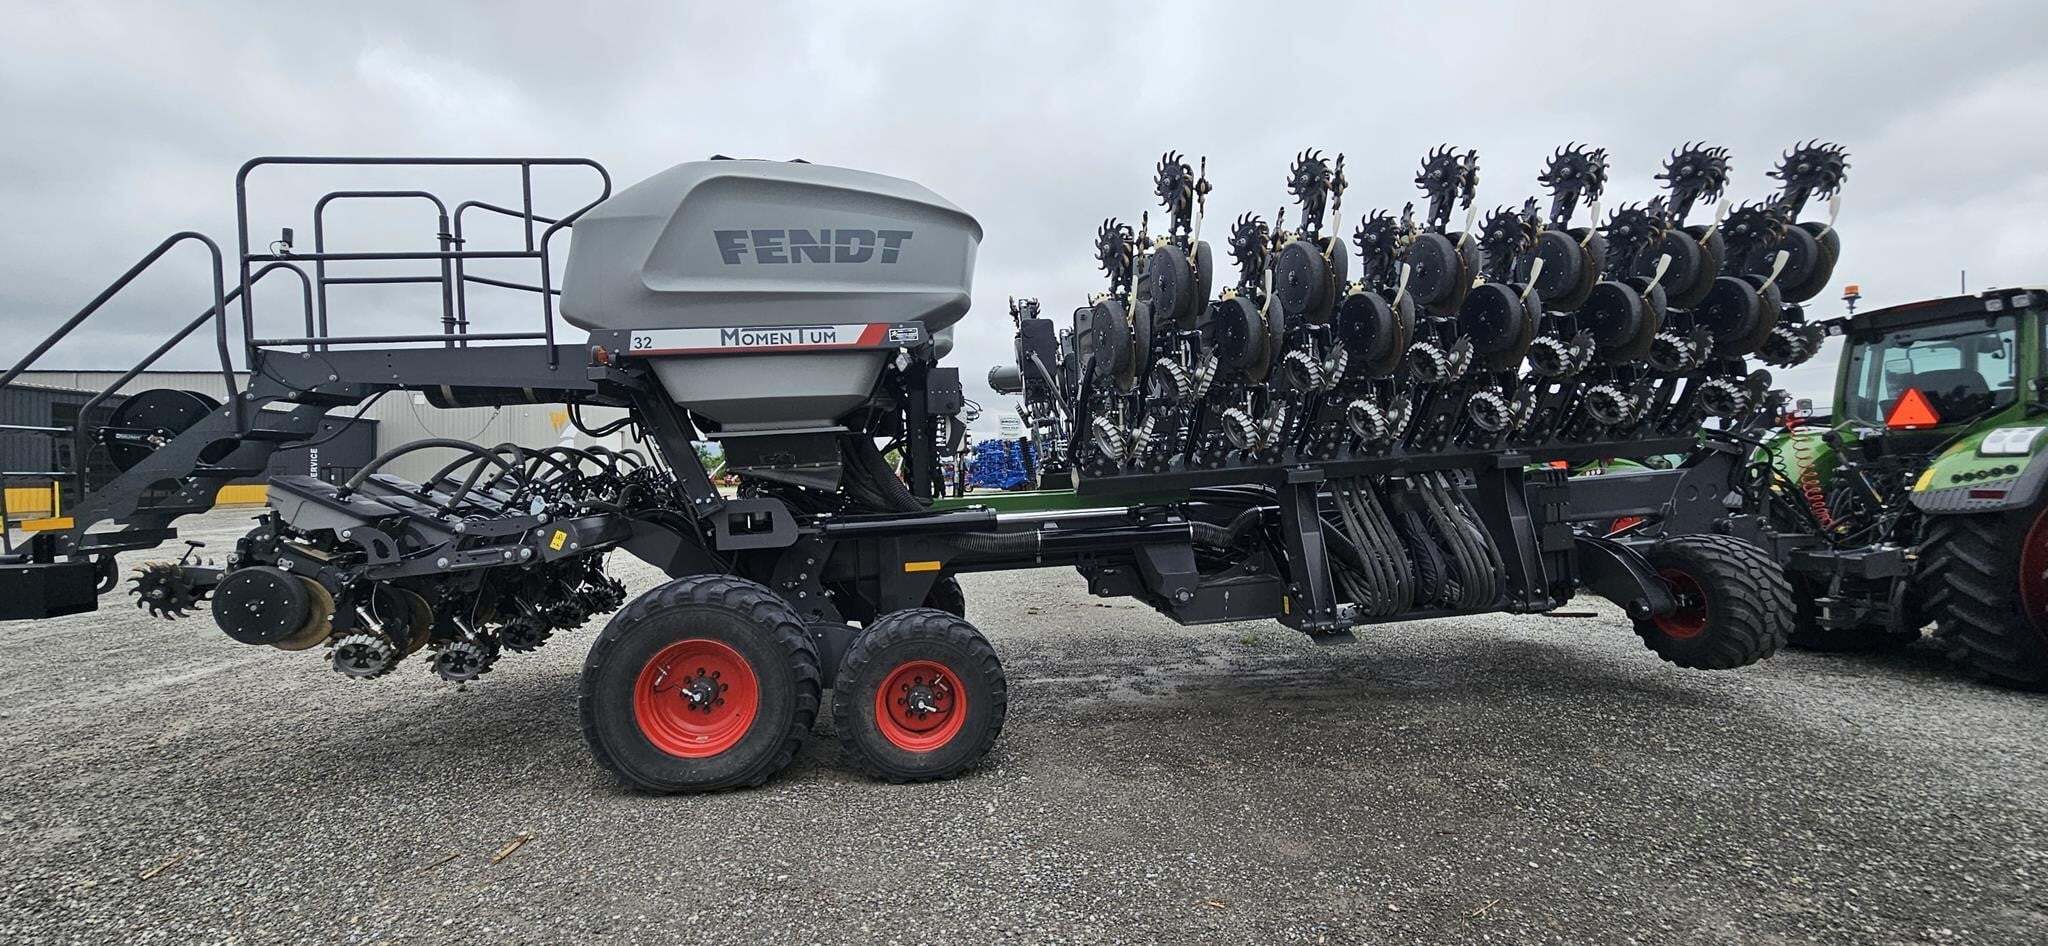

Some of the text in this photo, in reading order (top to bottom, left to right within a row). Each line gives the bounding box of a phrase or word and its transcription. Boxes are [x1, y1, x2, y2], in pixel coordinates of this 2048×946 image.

[713, 229, 914, 264] FENDT
[634, 337, 652, 349] 32
[310, 448, 318, 479] ERVICE
